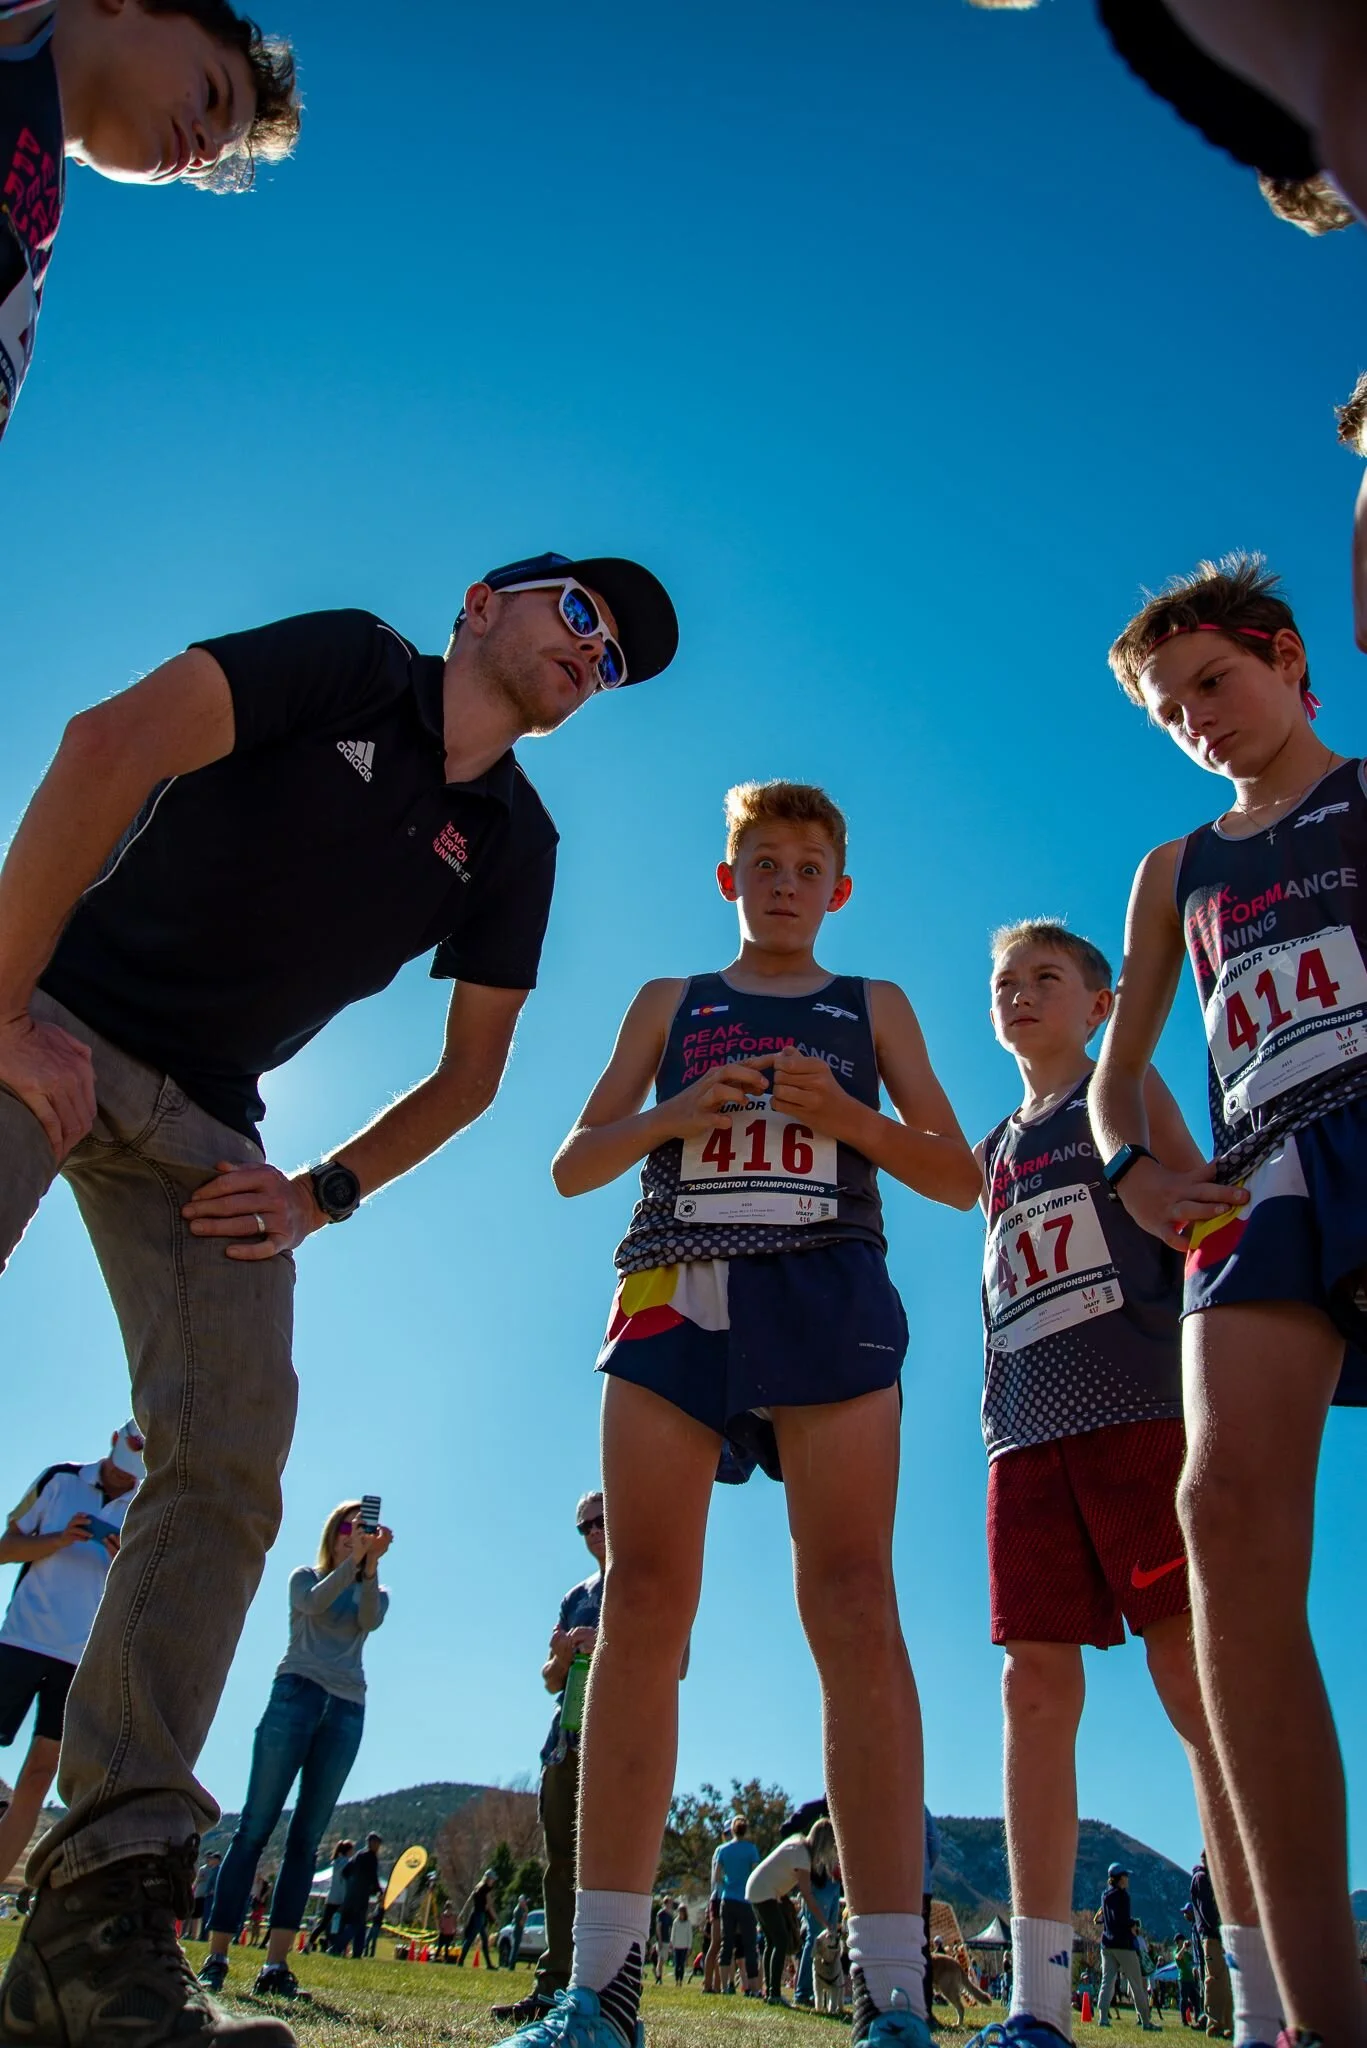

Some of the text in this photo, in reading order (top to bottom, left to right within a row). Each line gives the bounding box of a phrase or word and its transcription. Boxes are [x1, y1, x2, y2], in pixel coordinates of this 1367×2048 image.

[336, 741, 373, 782] adidas
[1187, 885, 1238, 938] PEAK.
[1226, 947, 1340, 1052] 414
[683, 1022, 749, 1047] PEAK.
[1277, 1009, 1363, 1047] CHAMPIONSHIPS
[1338, 1038, 1359, 1051] USATF
[683, 1036, 855, 1078] PERFORMANCE
[1344, 1046, 1358, 1056] 414
[701, 1119, 814, 1175] 416
[689, 1180, 826, 1193] ASSOCIATION CHAMPIONSHIPS
[1027, 1192, 1088, 1219] OLYMPIC
[998, 1214, 1074, 1298] 417
[996, 1295, 1036, 1326] ASSOCIATION
[1036, 1271, 1103, 1300] CHAMPIONSHIPS
[1083, 1299, 1101, 1310] USATF
[1089, 1305, 1100, 1315] 417
